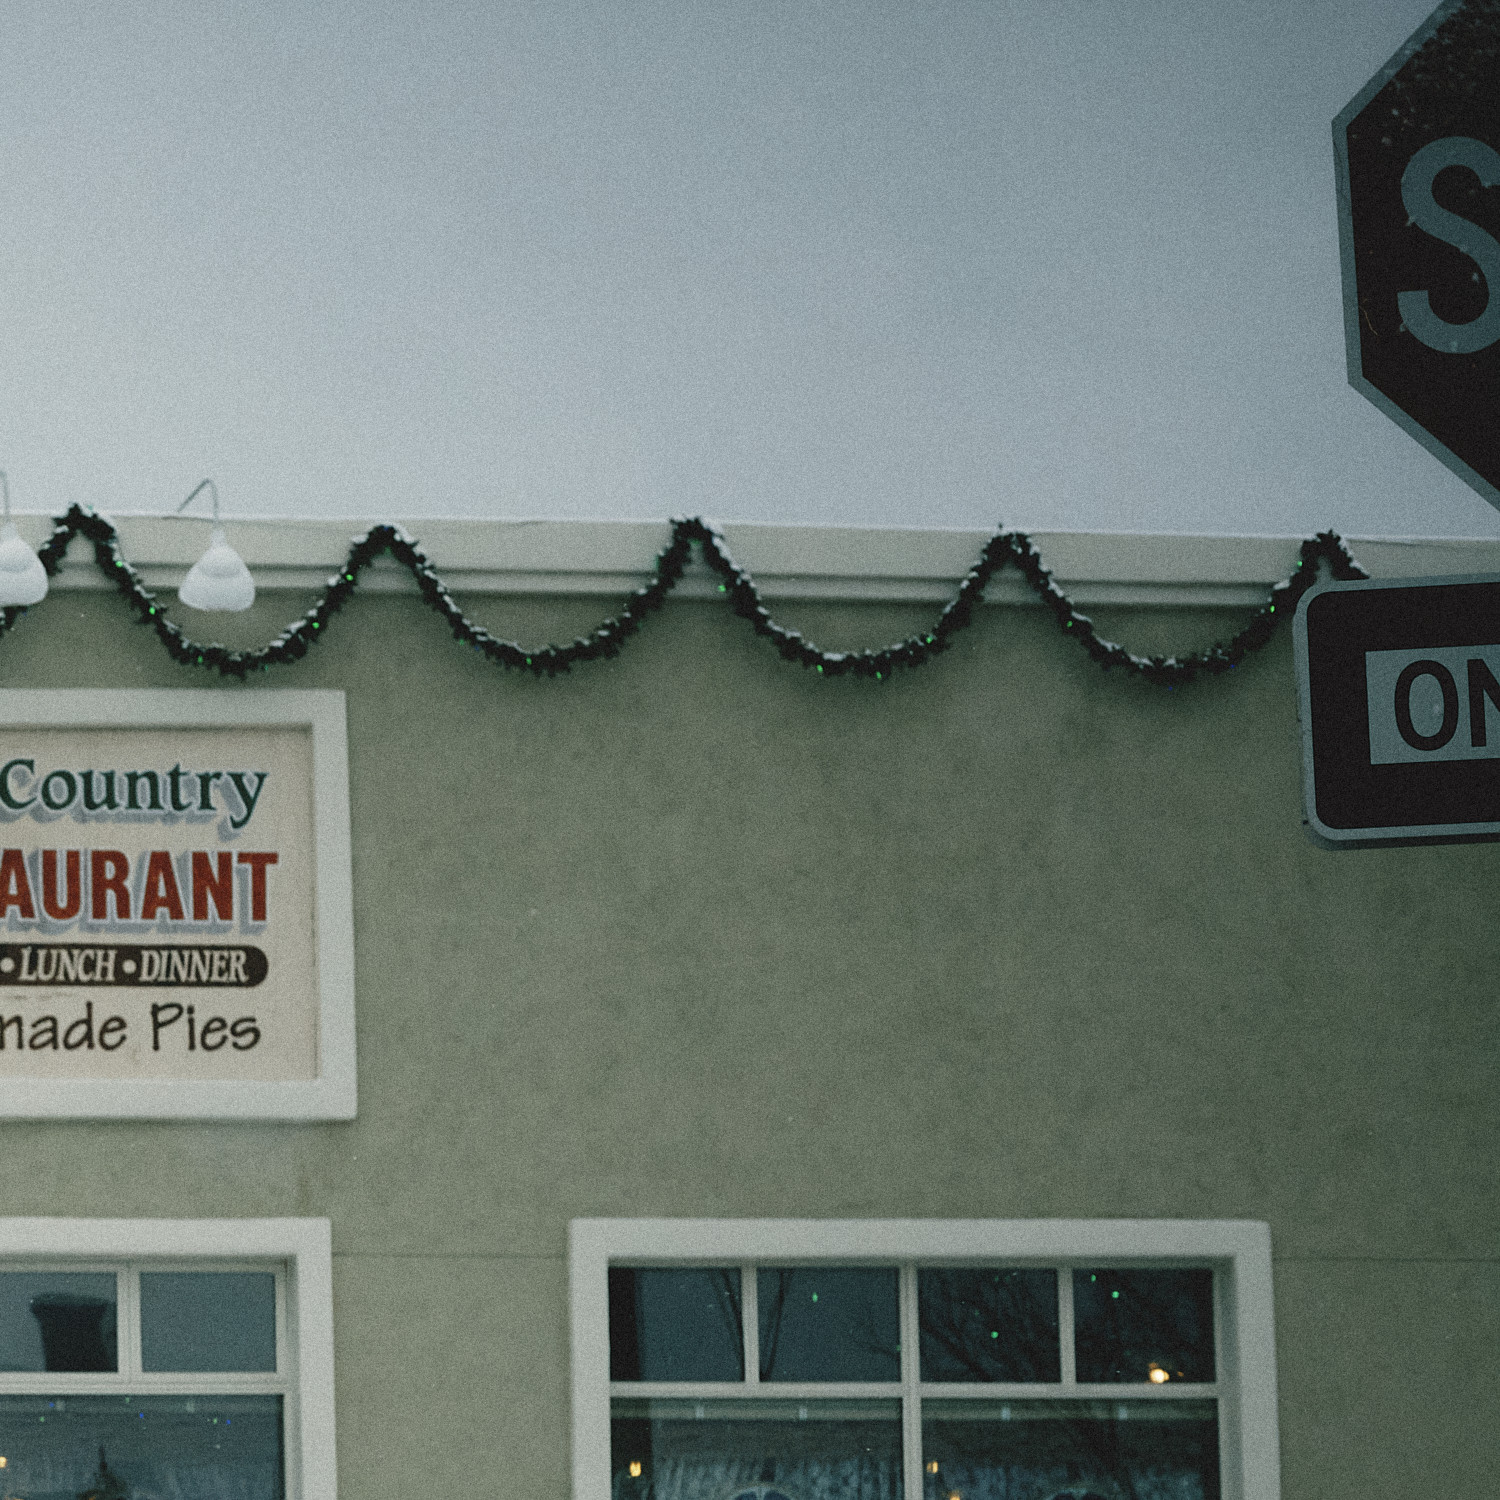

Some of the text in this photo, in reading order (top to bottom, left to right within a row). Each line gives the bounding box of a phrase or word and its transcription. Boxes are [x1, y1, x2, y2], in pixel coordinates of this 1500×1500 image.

[18, 948, 117, 983] LUNCH
[138, 948, 249, 984] DINNER
[150, 1002, 262, 1052] Pies
